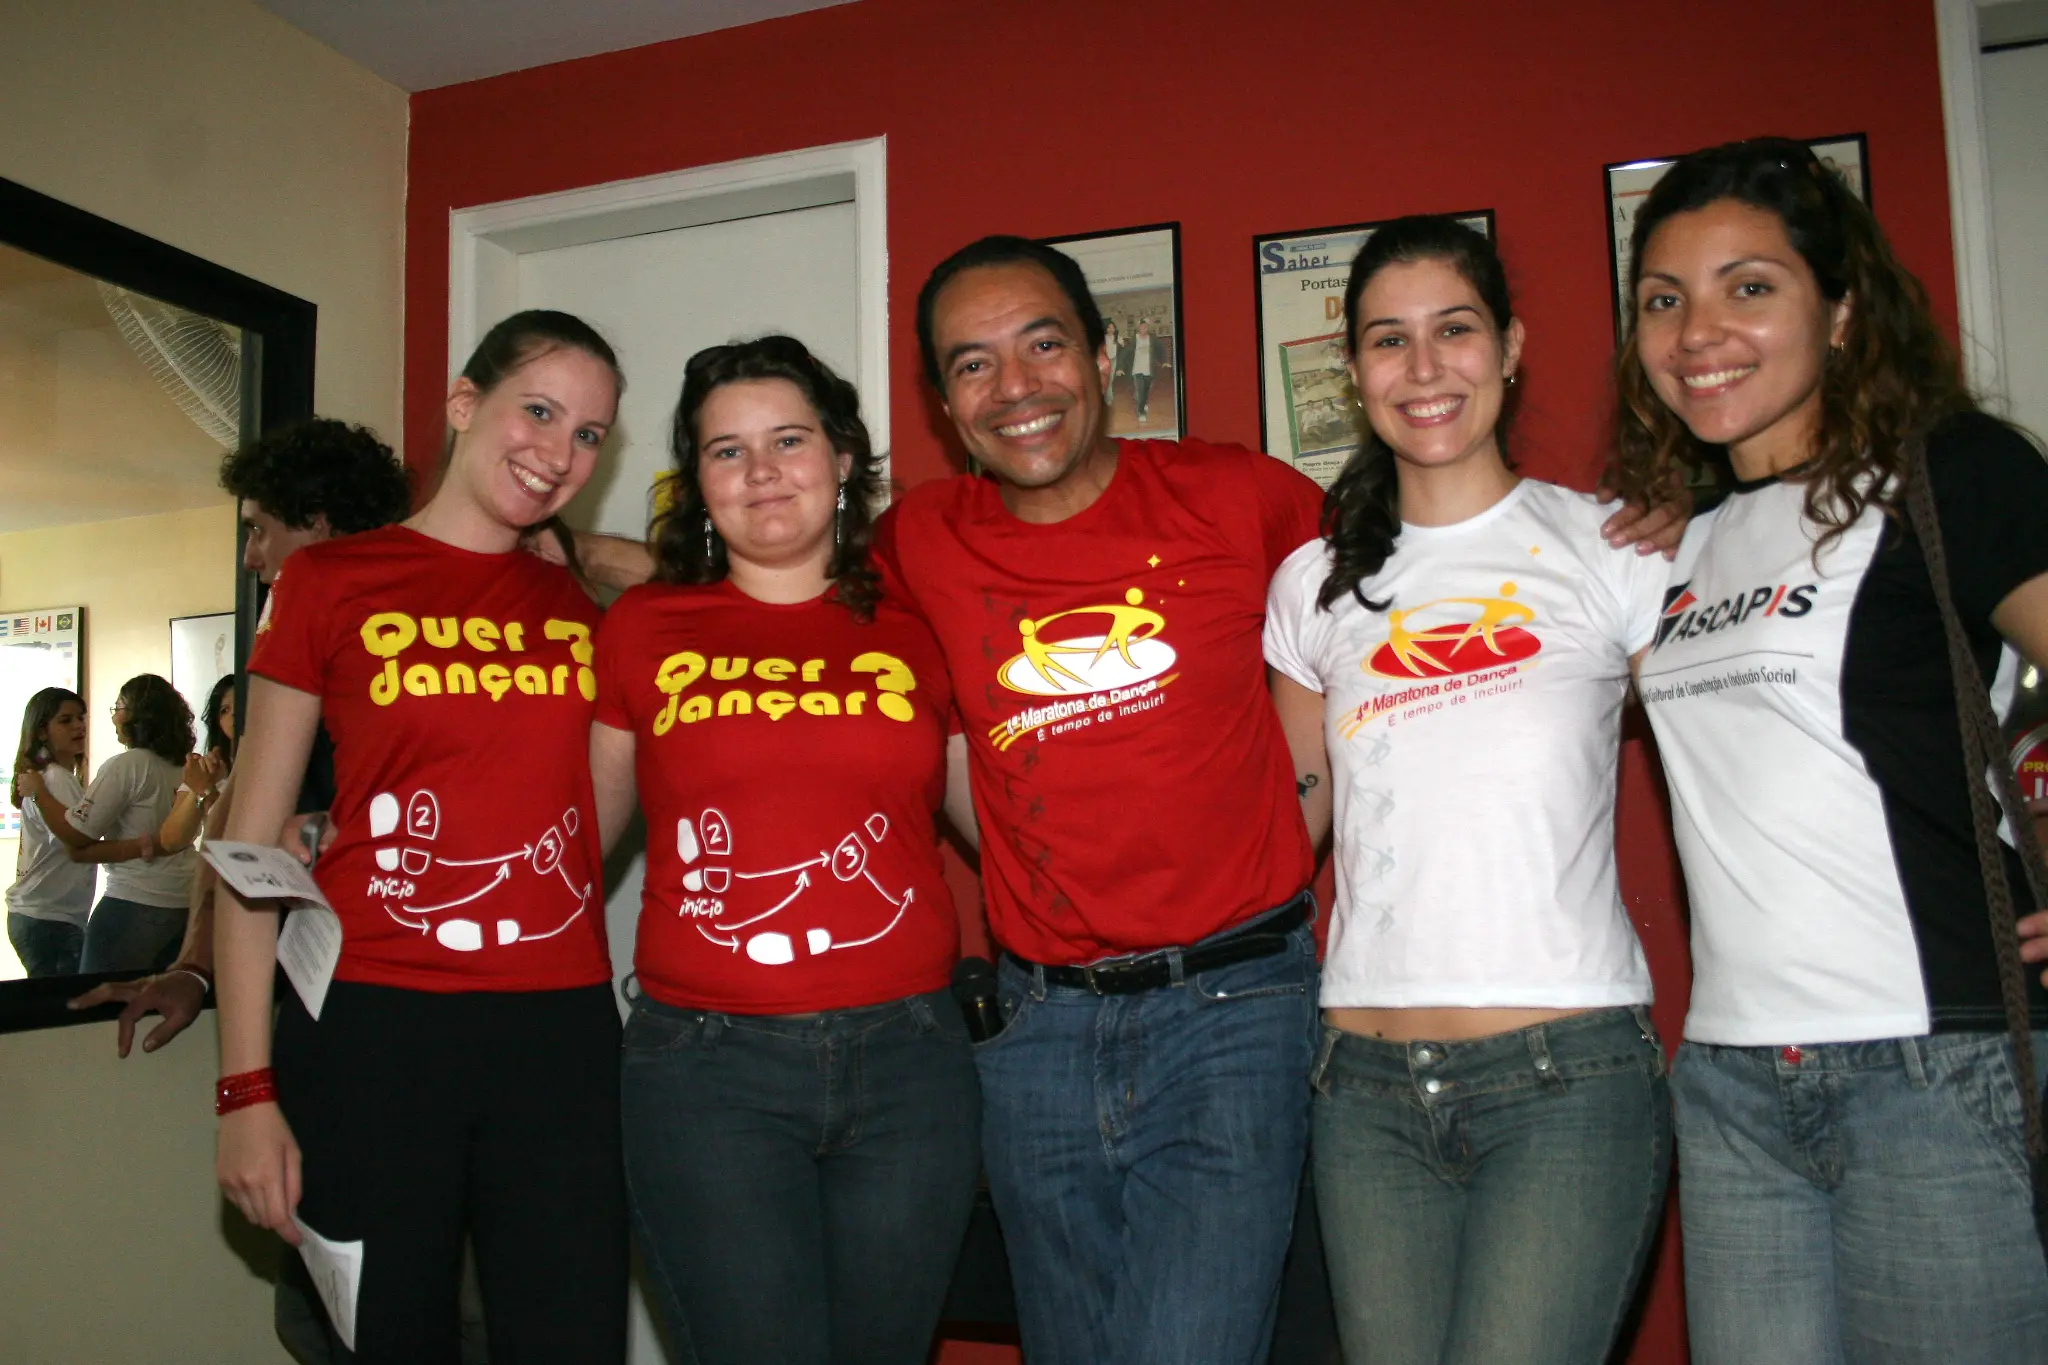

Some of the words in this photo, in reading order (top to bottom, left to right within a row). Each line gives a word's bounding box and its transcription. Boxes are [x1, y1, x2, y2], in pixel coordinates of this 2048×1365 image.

[1262, 242, 1329, 273] Saber
[1669, 584, 1818, 643] ASCAPIS
[360, 612, 523, 658] Quer
[654, 651, 826, 694] Quer
[1760, 665, 1796, 684] Social
[1020, 699, 1086, 730] Maratona
[1088, 693, 1107, 710] de
[1109, 680, 1157, 705] Dança
[1372, 684, 1439, 714] Maratona
[1444, 679, 1462, 692] de
[1467, 666, 1517, 687] Dança
[1051, 717, 1092, 736] tempo
[1097, 711, 1113, 723] de
[1119, 693, 1165, 716] incluir!
[1404, 701, 1443, 720] tempo
[1451, 695, 1466, 706] de
[415, 806, 430, 826] 2
[707, 824, 721, 844] 2
[543, 839, 557, 861] 3
[840, 846, 857, 868] 3
